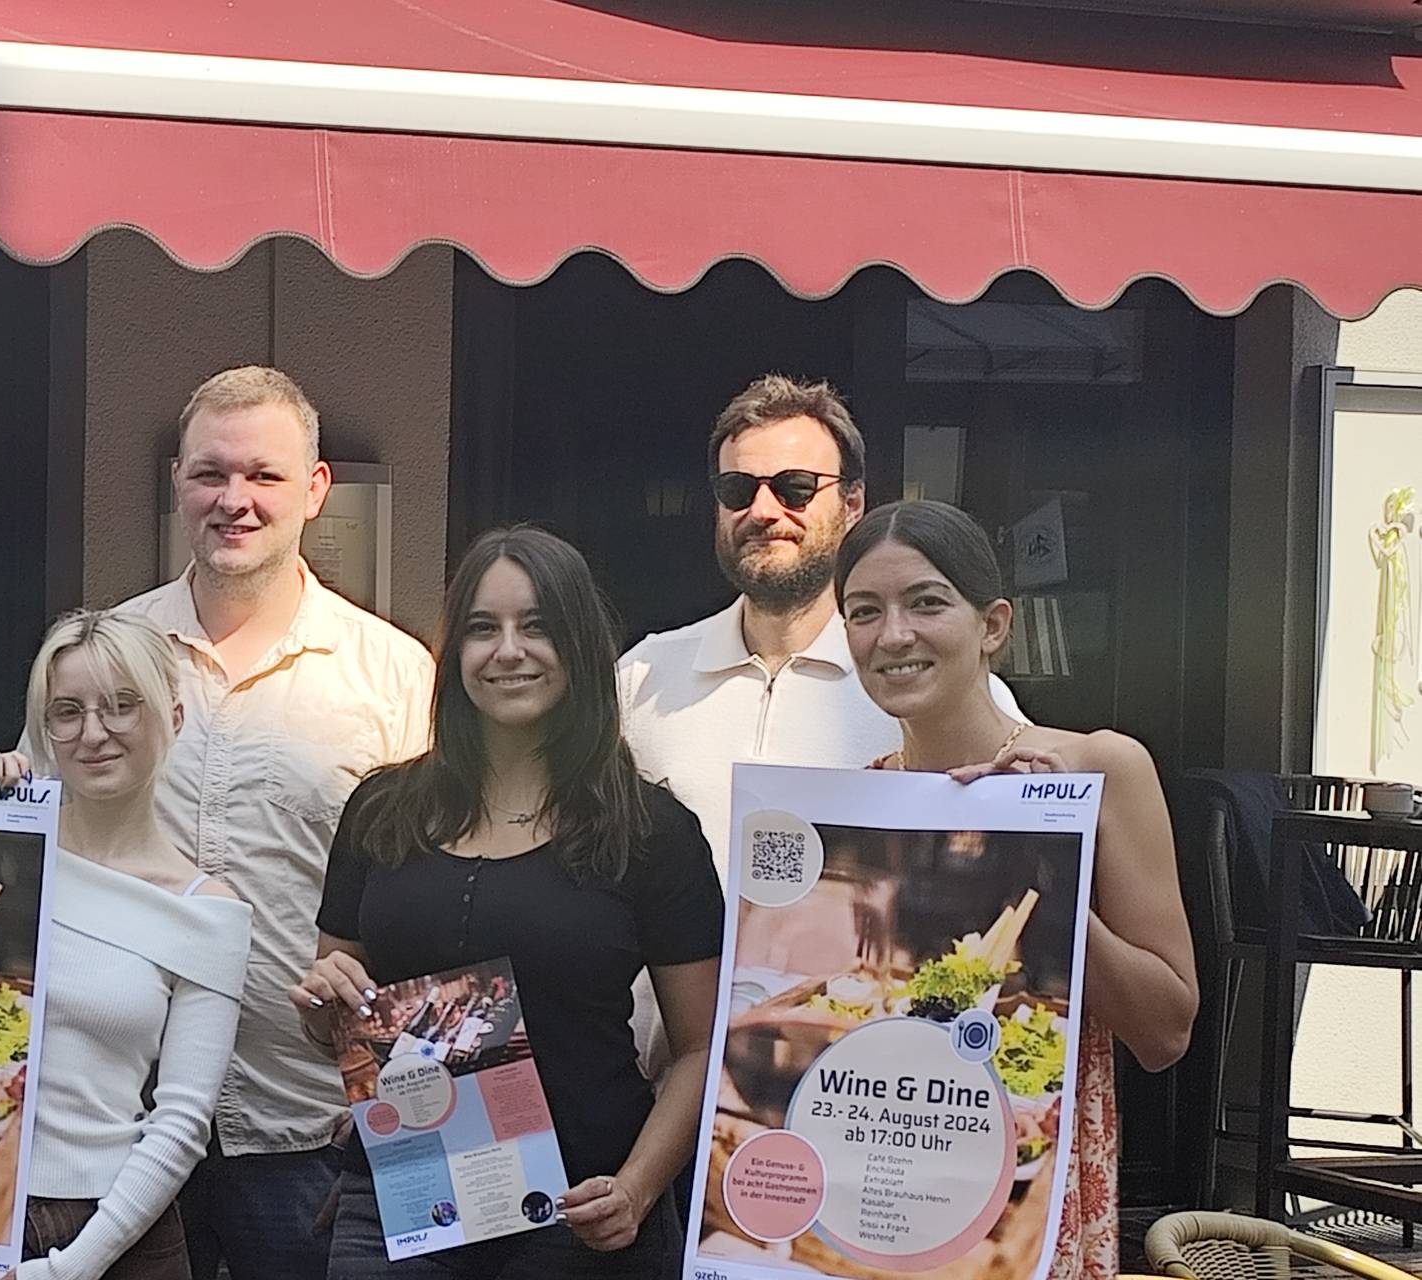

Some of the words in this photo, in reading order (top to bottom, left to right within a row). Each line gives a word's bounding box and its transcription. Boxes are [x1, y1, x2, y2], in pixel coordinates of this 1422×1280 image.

[1021, 783, 1092, 799] IMPULS
[819, 1068, 887, 1098] Wine
[896, 1076, 918, 1101] &
[926, 1079, 990, 1109] Dine
[848, 1104, 874, 1122] 24.
[878, 1108, 940, 1130] August
[943, 1114, 991, 1133] 2024
[844, 1126, 865, 1143] ab
[870, 1129, 916, 1148] 17:00
[921, 1134, 953, 1152] Uhr
